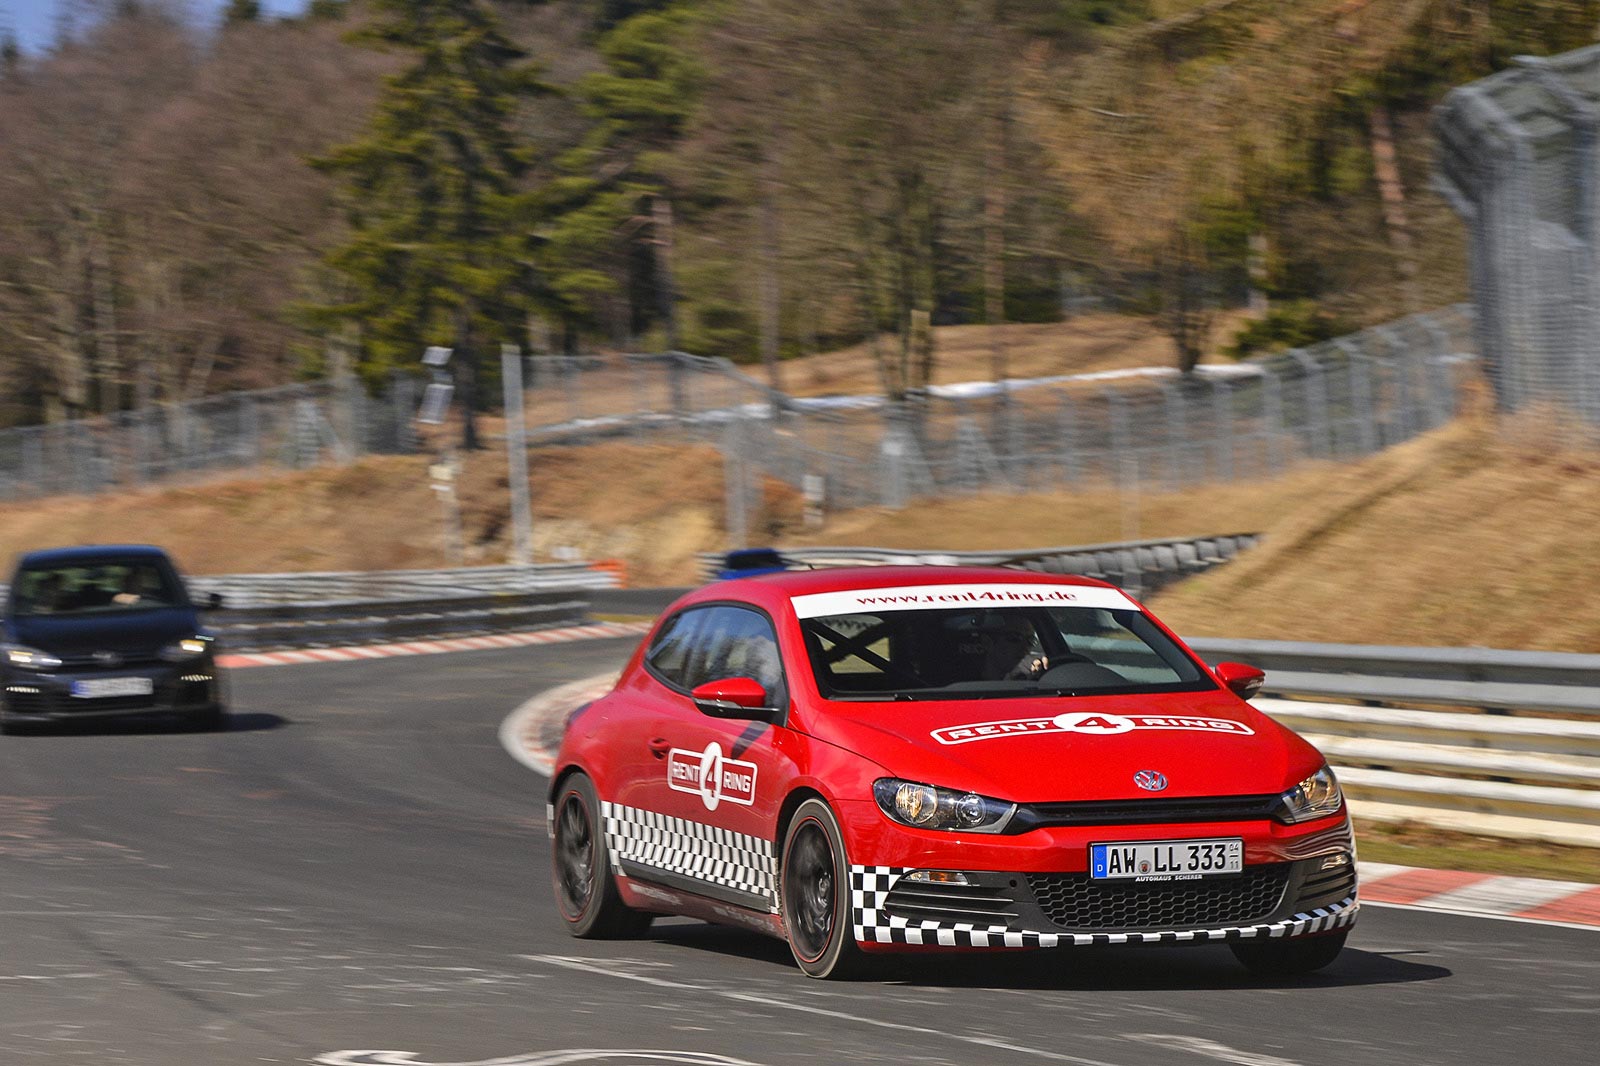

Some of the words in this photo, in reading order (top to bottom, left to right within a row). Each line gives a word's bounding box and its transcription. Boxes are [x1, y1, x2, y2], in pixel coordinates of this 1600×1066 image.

[856, 590, 1077, 605] www.rent4ring.de
[947, 720, 1050, 739] RENT
[1075, 716, 1124, 729] 4
[1140, 718, 1236, 729] RING
[673, 762, 701, 782] RENT
[705, 755, 718, 798] 4
[723, 771, 751, 792] RING
[1096, 864, 1103, 872] D
[1109, 848, 1136, 873] AW
[1154, 846, 1181, 872] LL
[1187, 844, 1226, 871] 333
